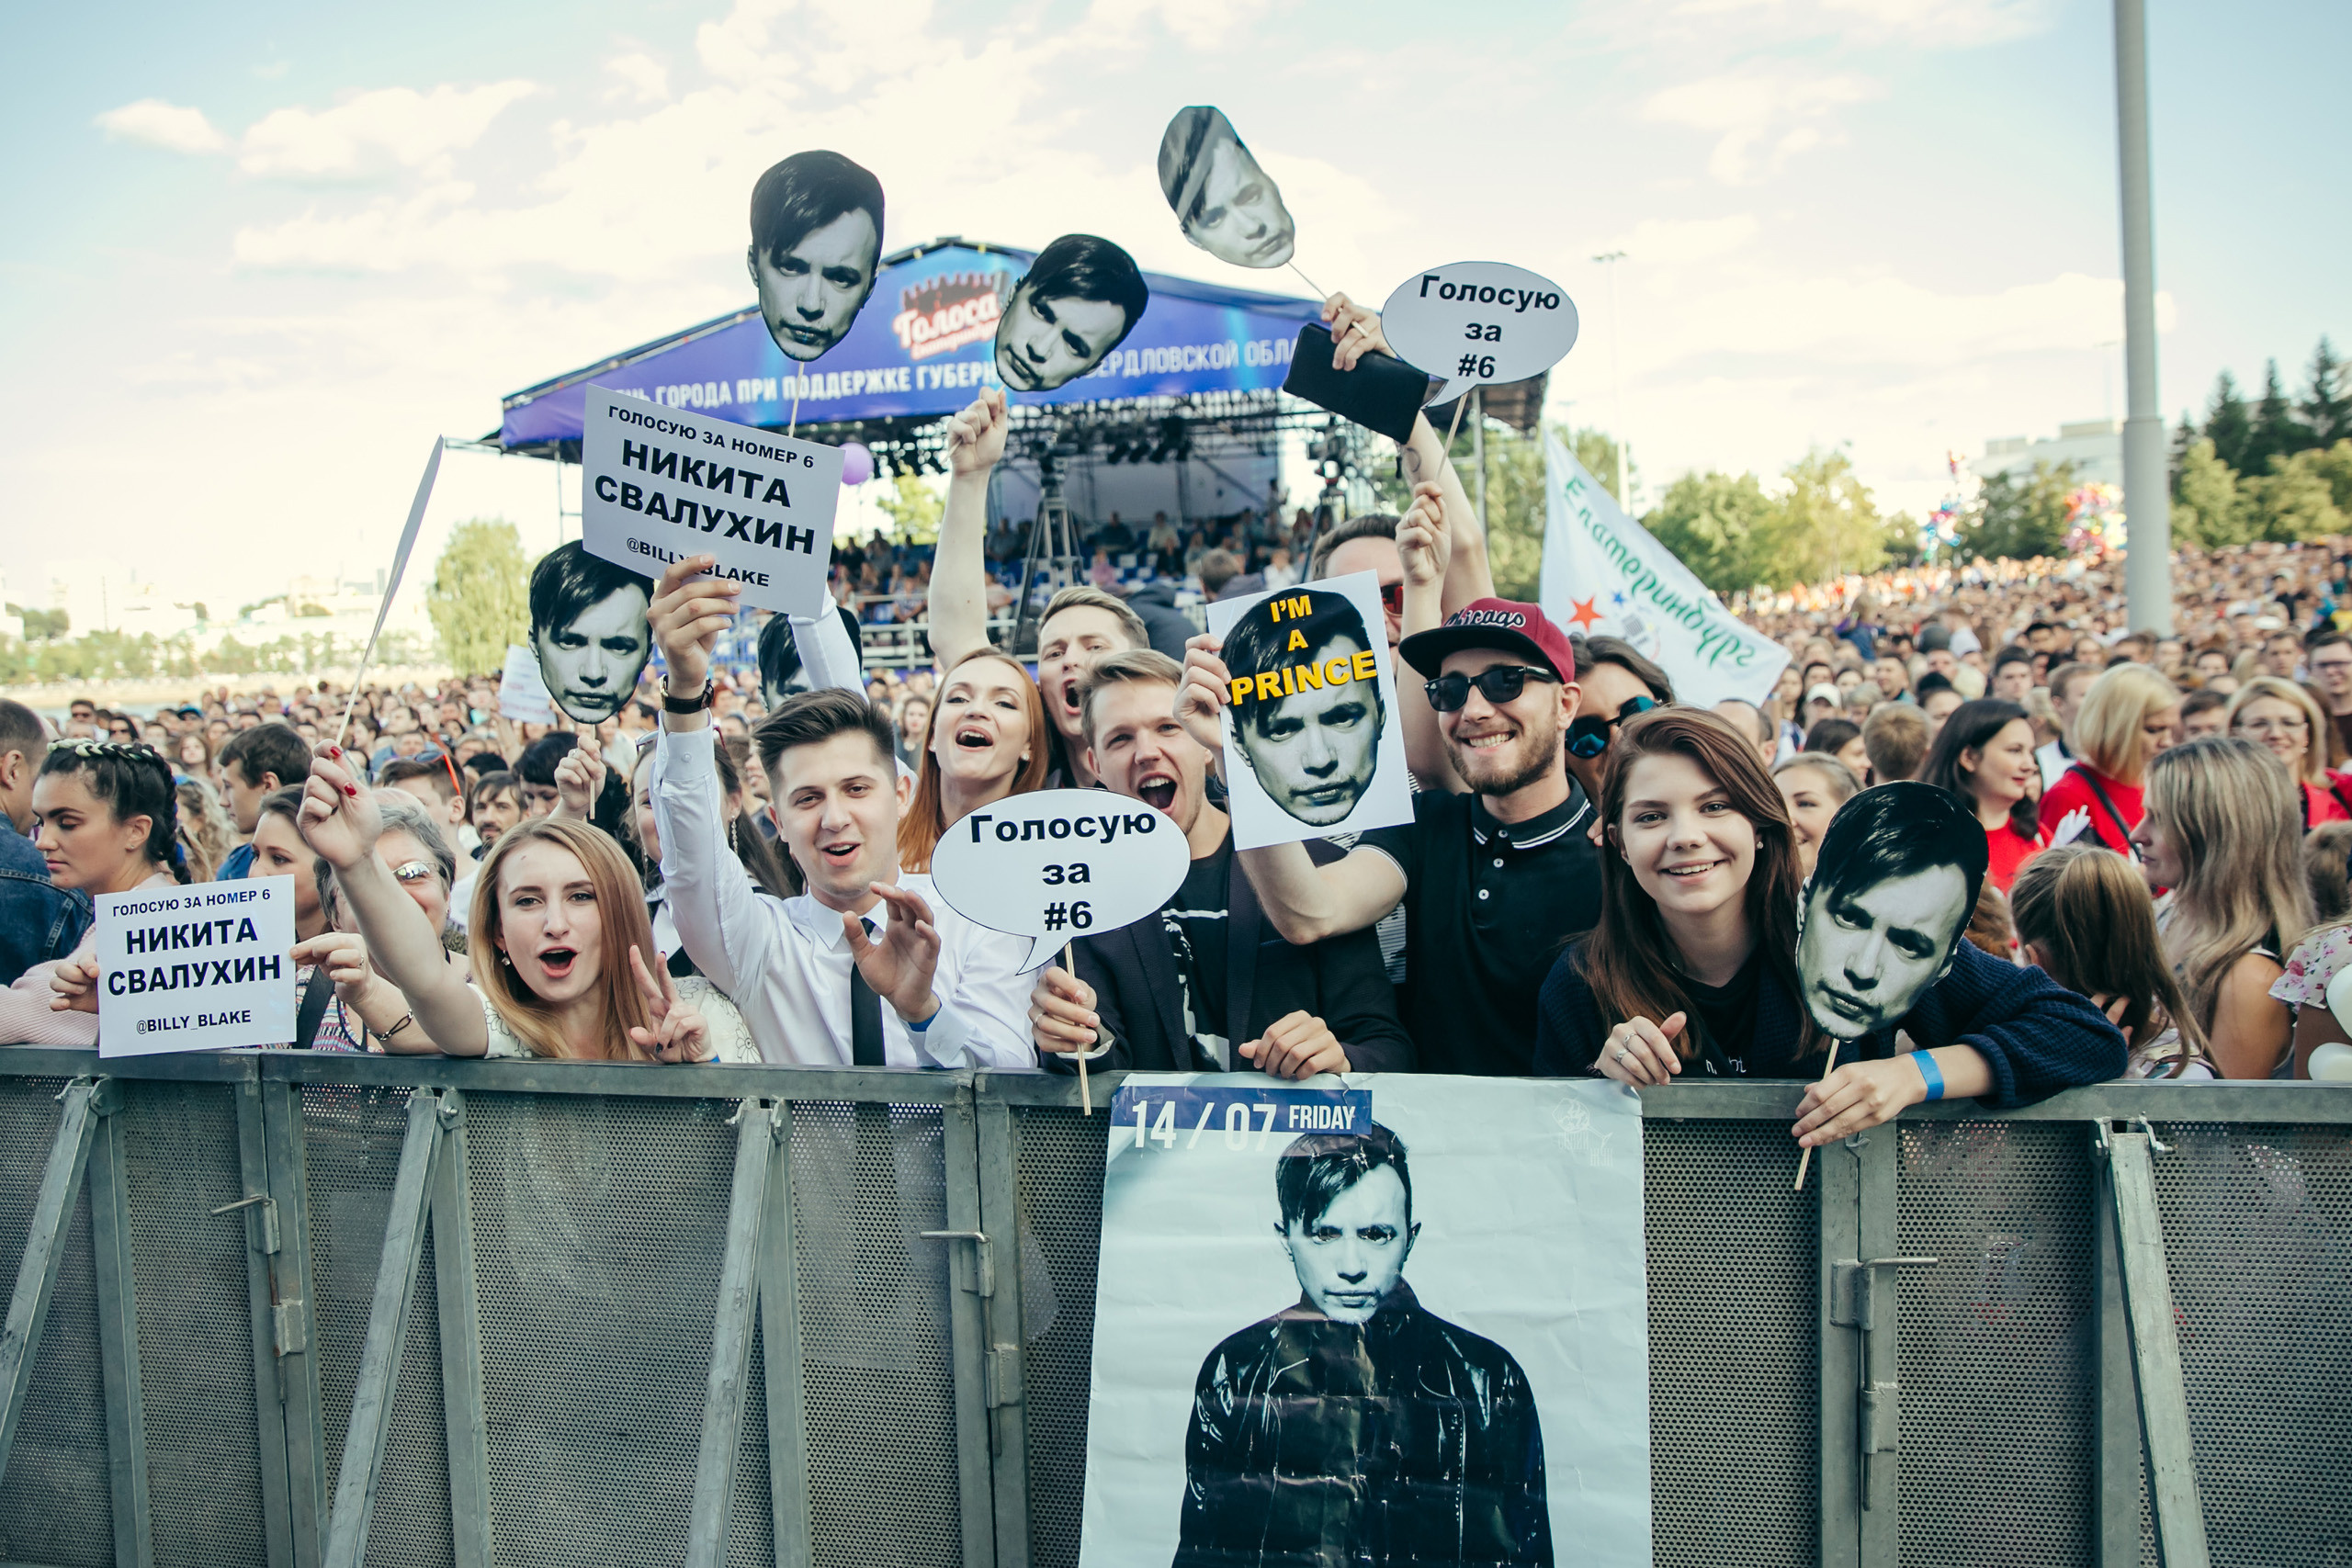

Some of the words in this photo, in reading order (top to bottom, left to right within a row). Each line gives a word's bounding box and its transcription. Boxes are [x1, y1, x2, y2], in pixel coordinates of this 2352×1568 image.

[1419, 274, 1560, 313] Голосую
[892, 291, 1001, 349] Голоса
[1464, 322, 1502, 343] за
[655, 381, 732, 410] ГОРОДА
[737, 377, 777, 404] ПРИ
[783, 366, 911, 401] ПОДДЕРЖКЕ
[916, 359, 1000, 392] ГУБЕРН
[1087, 338, 1239, 379] ЕРДЛОВСКОЙ
[1457, 353, 1496, 378] #6
[608, 405, 697, 440] ГОЛОСУЮ
[702, 431, 726, 448] ЗА
[731, 437, 797, 464] НОМЕР
[803, 455, 814, 468] 6
[622, 438, 791, 508] НИКИТА
[594, 474, 815, 555] СВАЛУХИН
[627, 537, 770, 587] @BILLBLAKE
[1270, 594, 1313, 623] I'M
[1287, 628, 1309, 651] A
[1230, 649, 1377, 705] PRINCE
[970, 813, 1157, 844] Голосую
[1042, 863, 1091, 886] за
[112, 898, 179, 918] ГОЛОСУЮ
[184, 896, 202, 909] ЗА
[206, 890, 257, 907] НОМЕР
[262, 888, 271, 900] 6
[1044, 900, 1093, 931] #6
[126, 917, 258, 955] НИКИТА
[107, 954, 280, 996] СВАЛУХИН
[136, 1010, 252, 1035] @BILLY_BLAKE
[1289, 1105, 1356, 1130] FRIDAY
